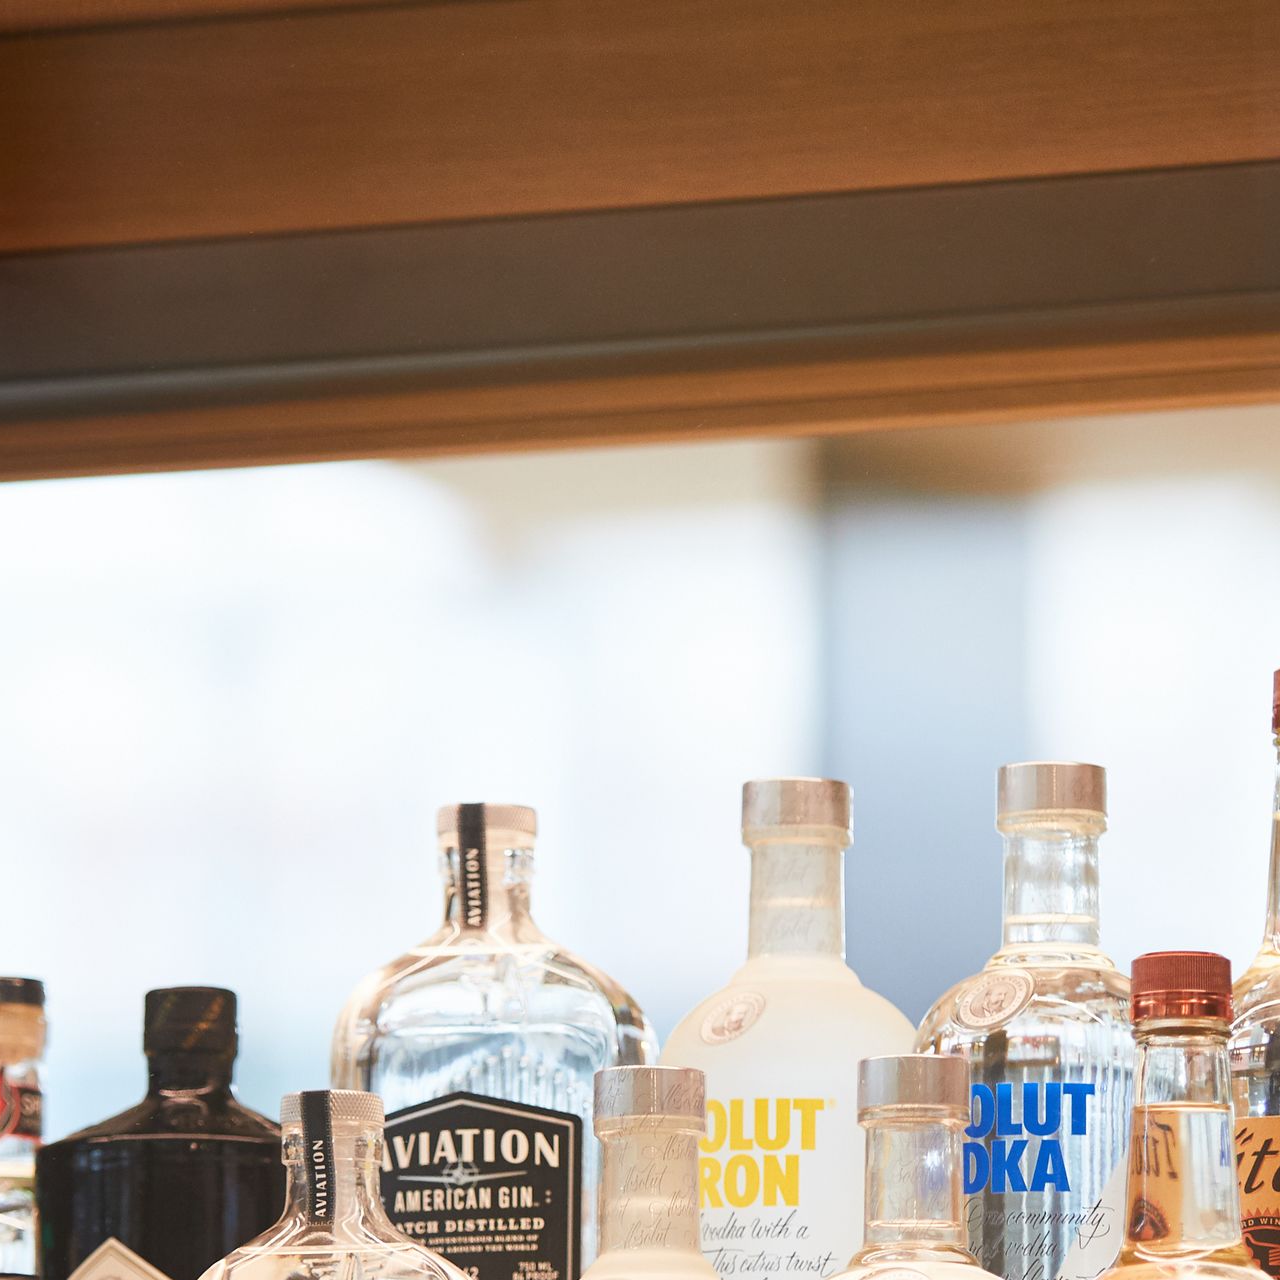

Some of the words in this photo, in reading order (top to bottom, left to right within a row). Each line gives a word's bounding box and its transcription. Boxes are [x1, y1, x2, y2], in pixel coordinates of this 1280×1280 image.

[466, 847, 482, 927] AVIATION
[697, 1098, 825, 1151] OLUT
[964, 1082, 1096, 1139] OLUT
[312, 1139, 328, 1218] AVIATION
[698, 1154, 800, 1208] RON
[963, 1139, 1071, 1195] DKA
[394, 1187, 492, 1213] AMERICAN
[498, 1186, 533, 1208] GIN
[750, 1209, 798, 1240] with
[795, 1224, 811, 1240] a
[395, 1220, 439, 1235] ATCH
[445, 1218, 546, 1233] DISTILLED
[739, 1250, 782, 1273] citrus
[786, 1251, 839, 1279] twist
